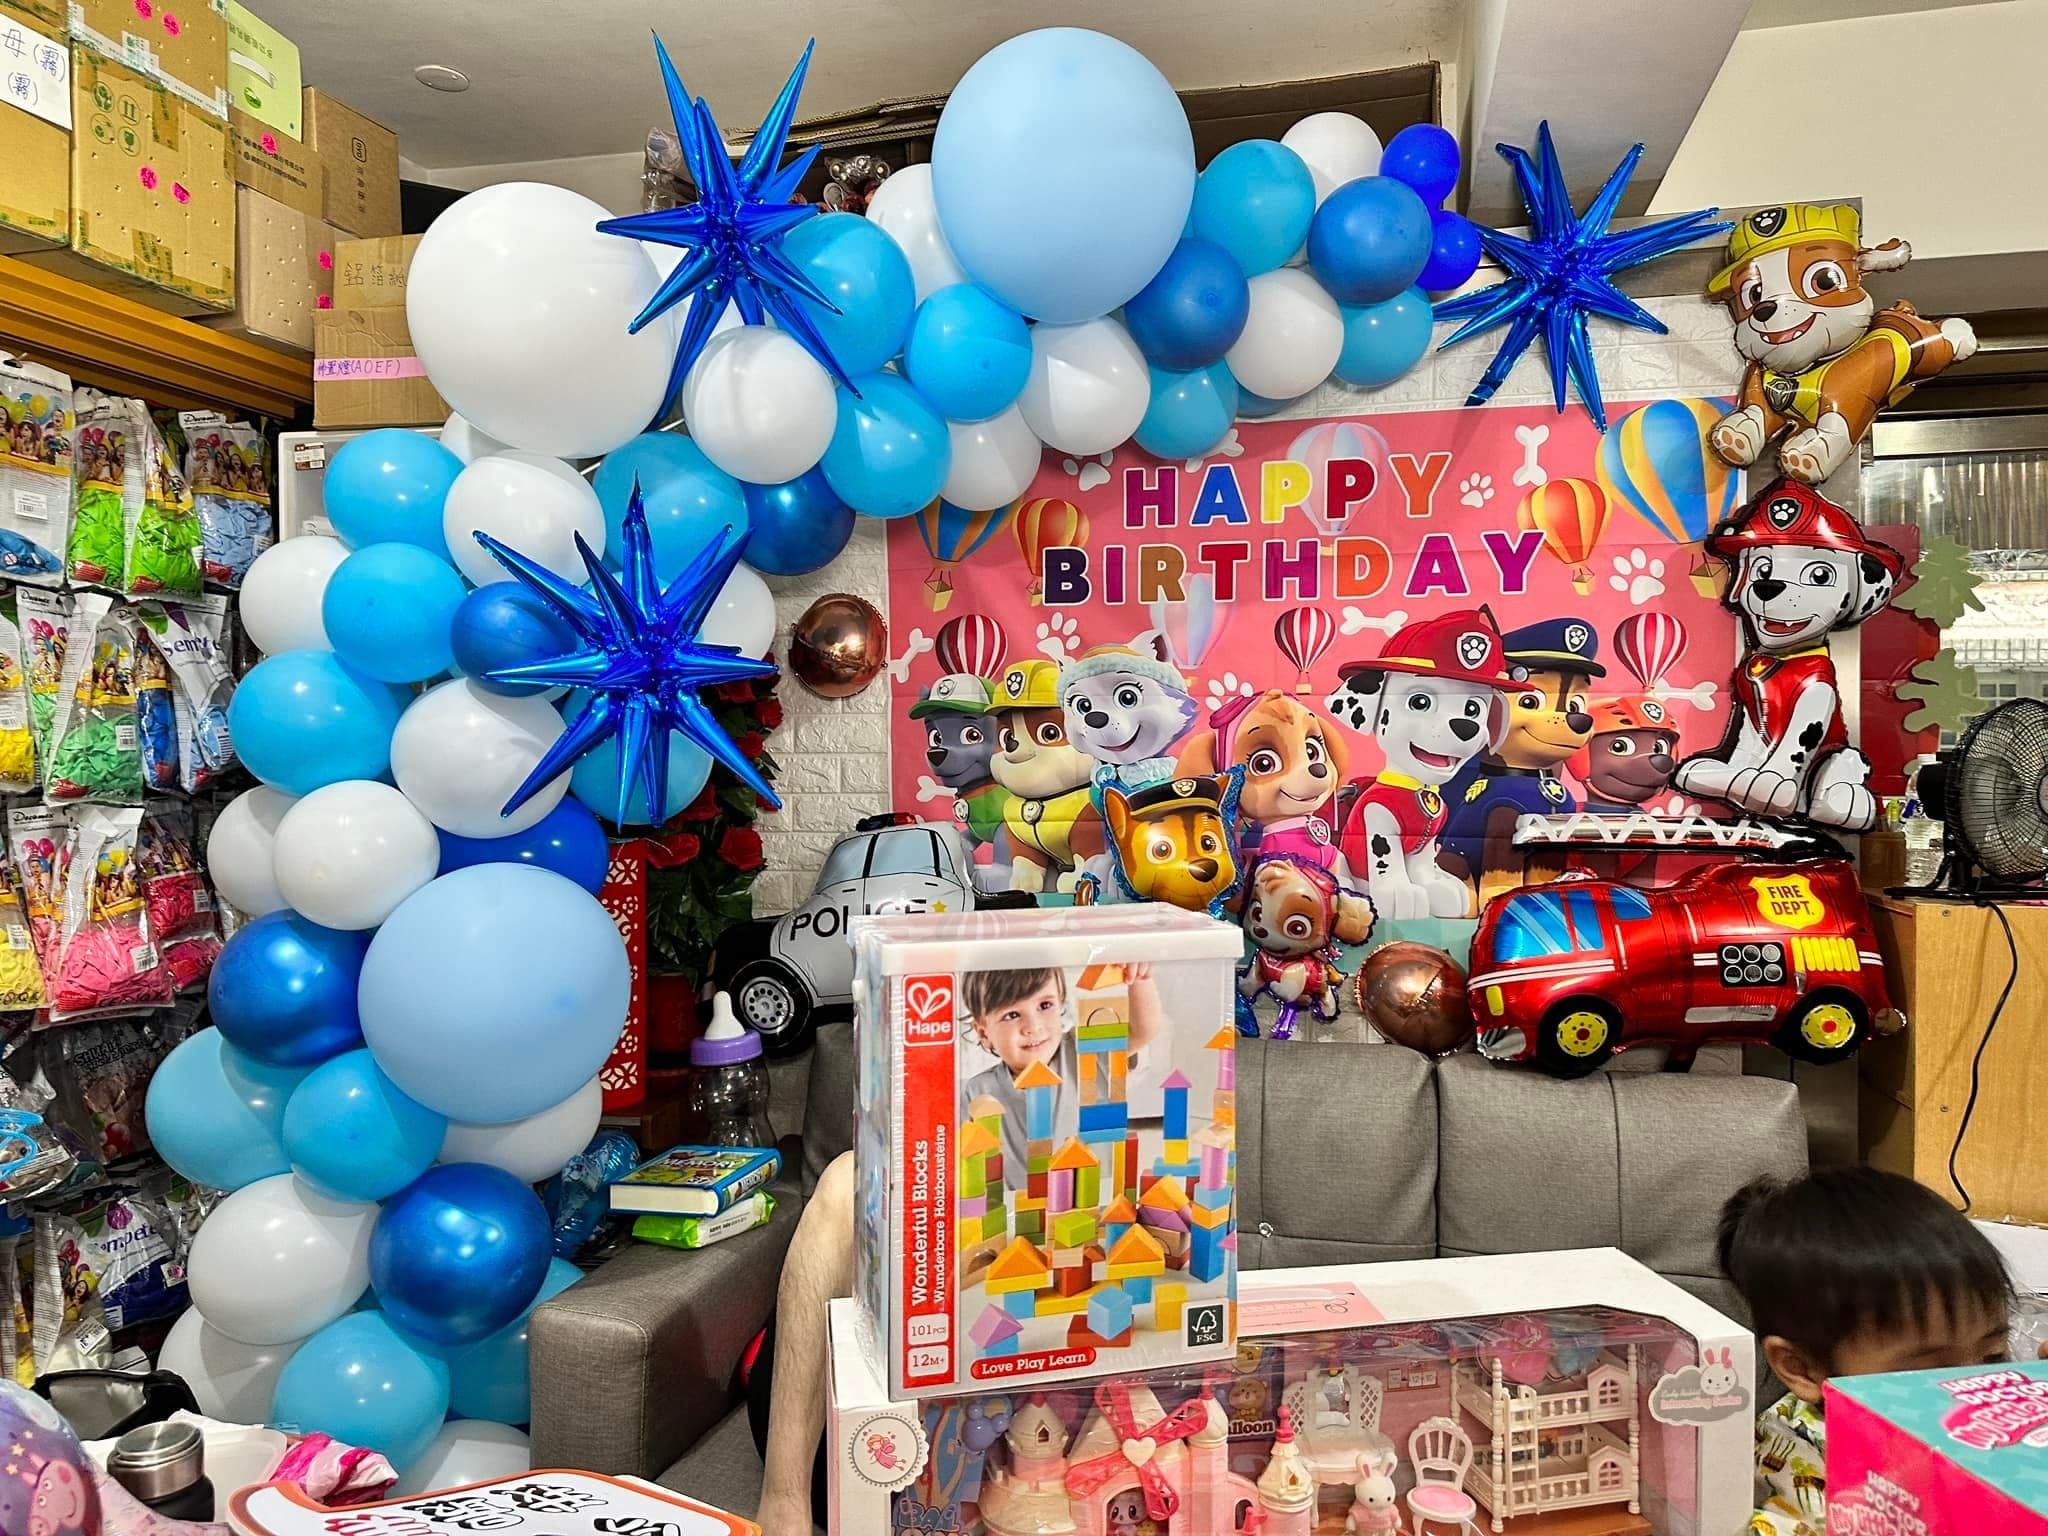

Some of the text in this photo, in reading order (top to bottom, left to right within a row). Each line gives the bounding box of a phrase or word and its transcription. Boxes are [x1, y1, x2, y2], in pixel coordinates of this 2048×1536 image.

[1123, 452, 1452, 530] HAPPY
[1041, 530, 1545, 605] BIRTHDAY
[1767, 885, 1803, 899] FIRE
[1770, 901, 1815, 915] DEPT.
[907, 1019, 950, 1036] Hape
[912, 1140, 928, 1306] Wonderful Blocks
[934, 1124, 946, 1303] Wunderbare Holzbausteine
[1196, 1332, 1217, 1343] FSC
[912, 1354, 945, 1368] 12M+
[982, 1352, 1087, 1375] Love Play Learn
[1941, 1371, 2021, 1393] HAPPY
[1867, 1469, 1919, 1512] HAPPY
